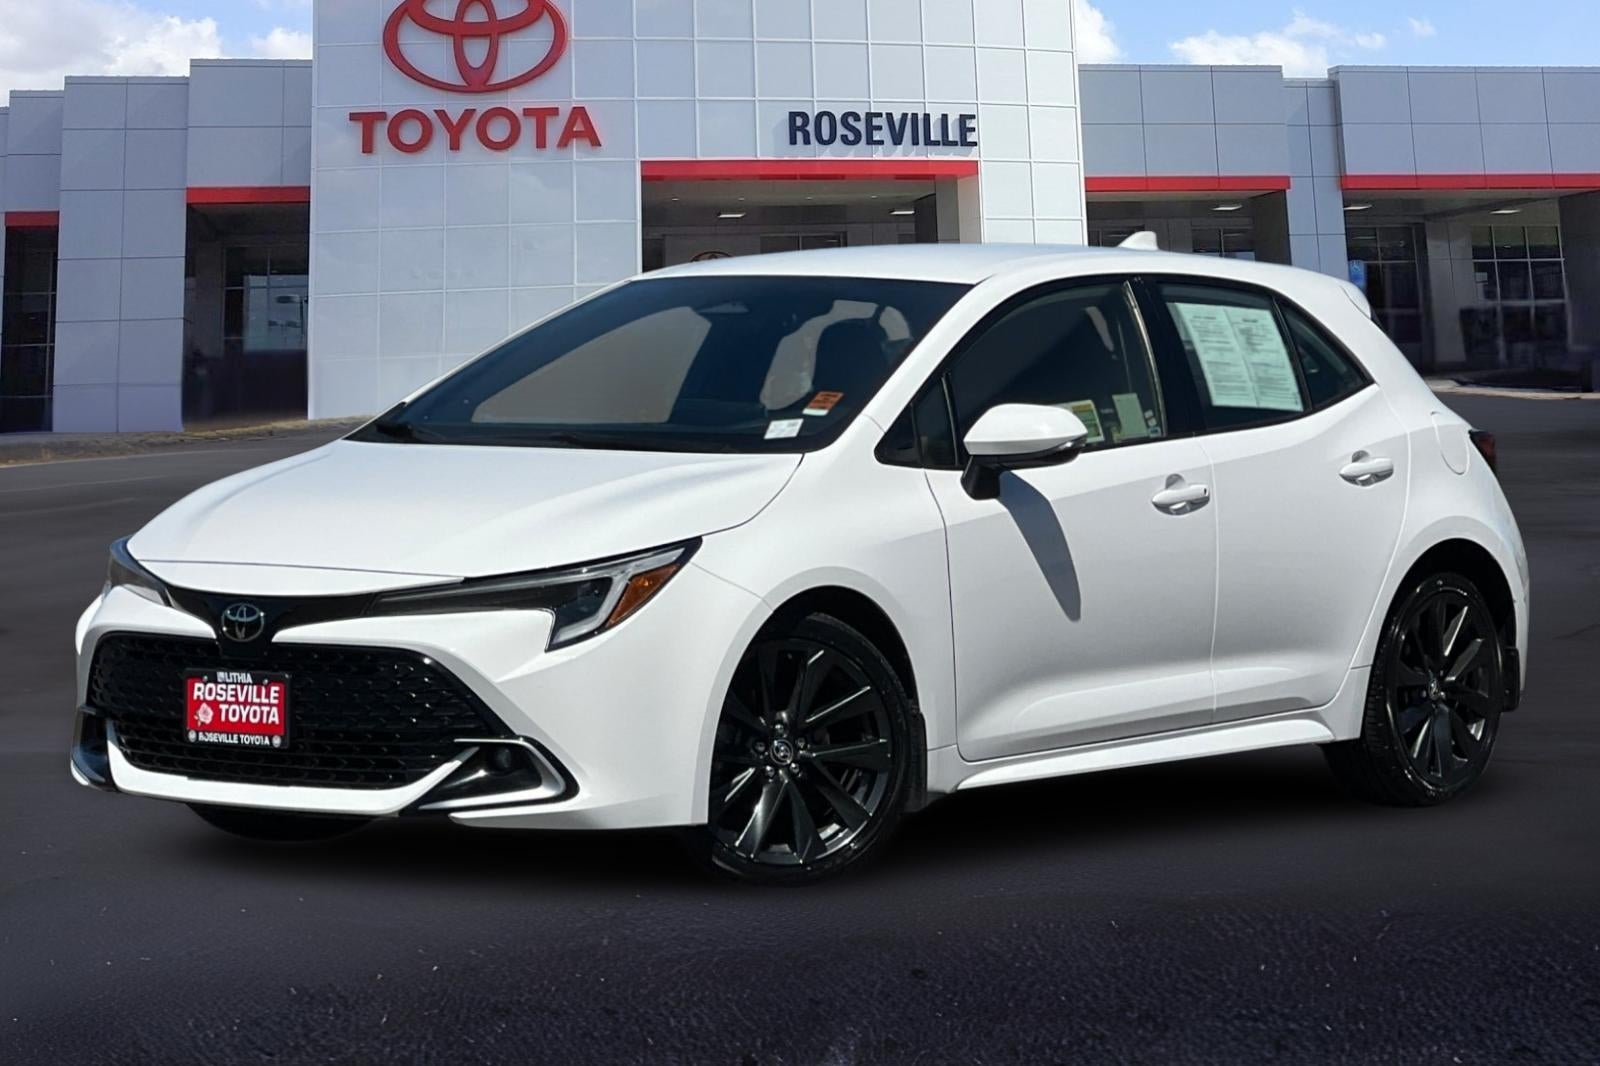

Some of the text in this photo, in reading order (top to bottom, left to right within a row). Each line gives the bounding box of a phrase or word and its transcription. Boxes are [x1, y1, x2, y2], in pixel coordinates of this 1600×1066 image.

[348, 106, 602, 154] TOYOTA
[788, 110, 978, 147] ROSEVILLE
[225, 671, 253, 684] LITHIA
[193, 682, 280, 704] ROSEVILLE
[219, 704, 280, 725] TOYOTA
[240, 734, 270, 746] TOYOTA
